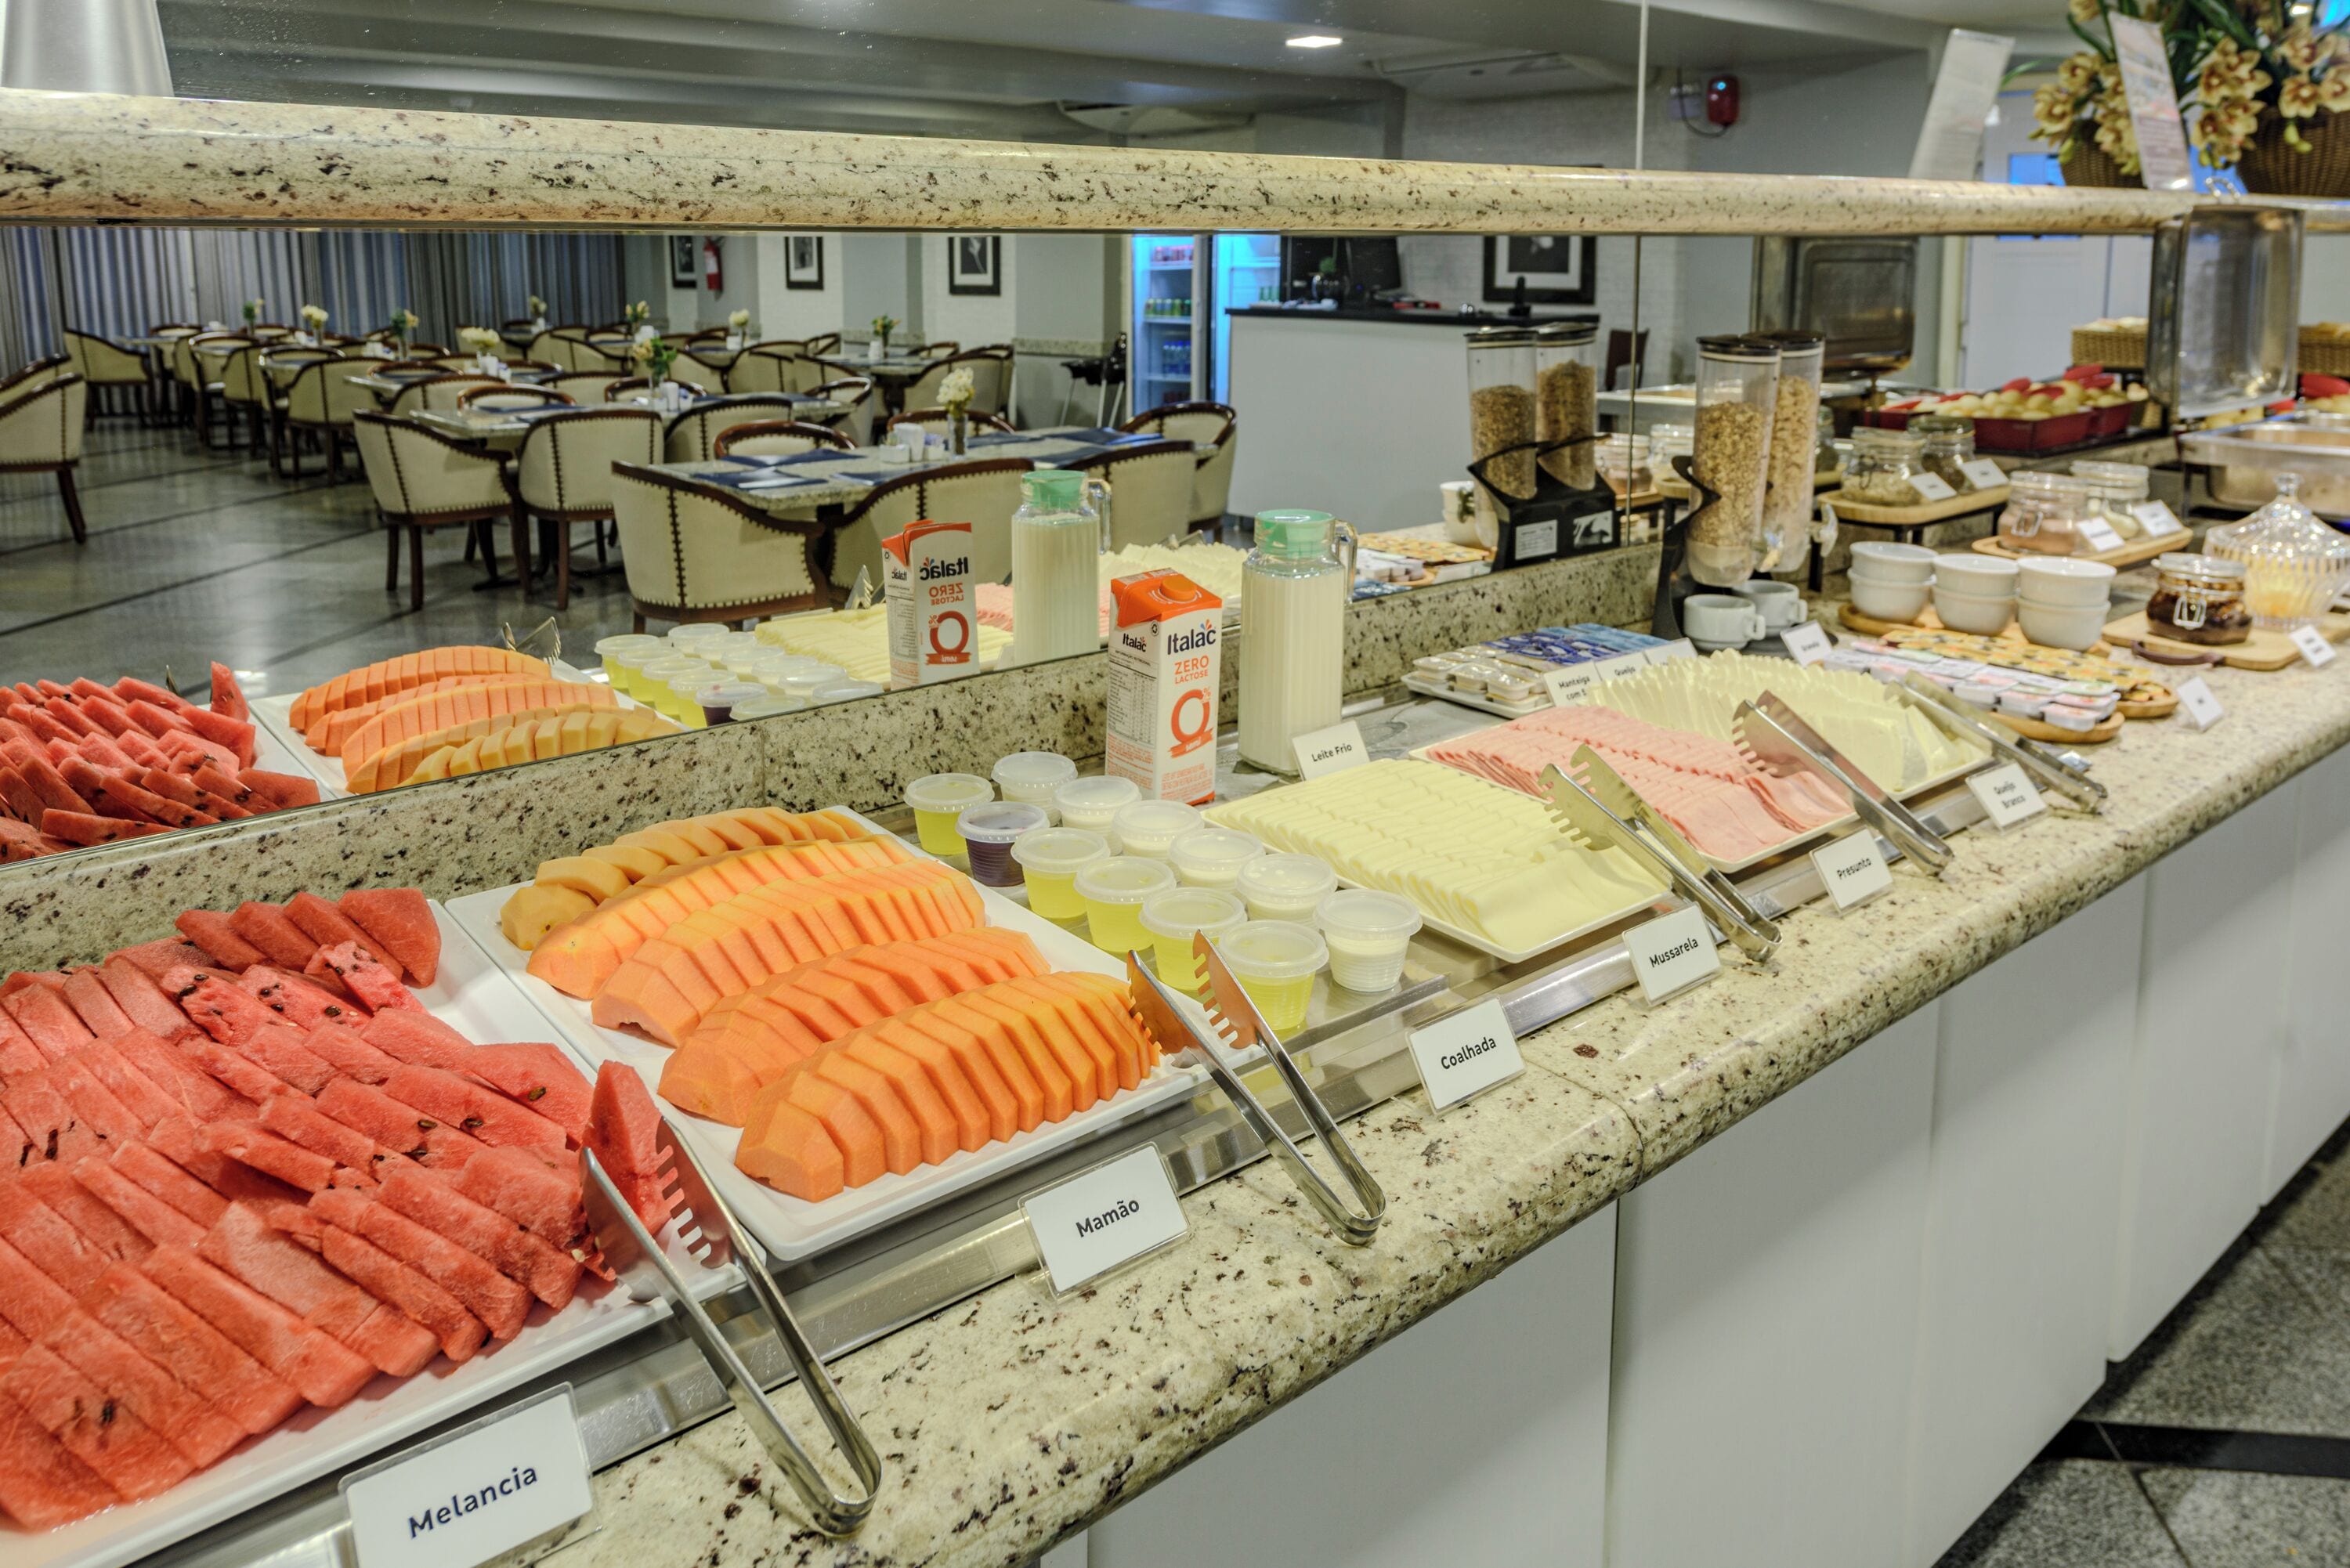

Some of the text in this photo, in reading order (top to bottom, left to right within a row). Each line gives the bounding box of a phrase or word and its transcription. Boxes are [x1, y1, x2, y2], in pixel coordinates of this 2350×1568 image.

[1123, 633, 1147, 652] Italac
[1167, 629, 1217, 655] Italac
[1174, 655, 1209, 675] ZERO
[1175, 669, 1209, 685] LACTOSE
[1558, 675, 1590, 688] Manteiga
[1567, 691, 1581, 700] com
[1311, 743, 1352, 762] Leite Frio
[1837, 858, 1871, 880] Presunto
[1649, 938, 1698, 967] Mussarela
[1441, 1037, 1497, 1069] Coalhada
[1075, 1199, 1140, 1237] Mamão
[407, 1467, 537, 1539] Melancia
